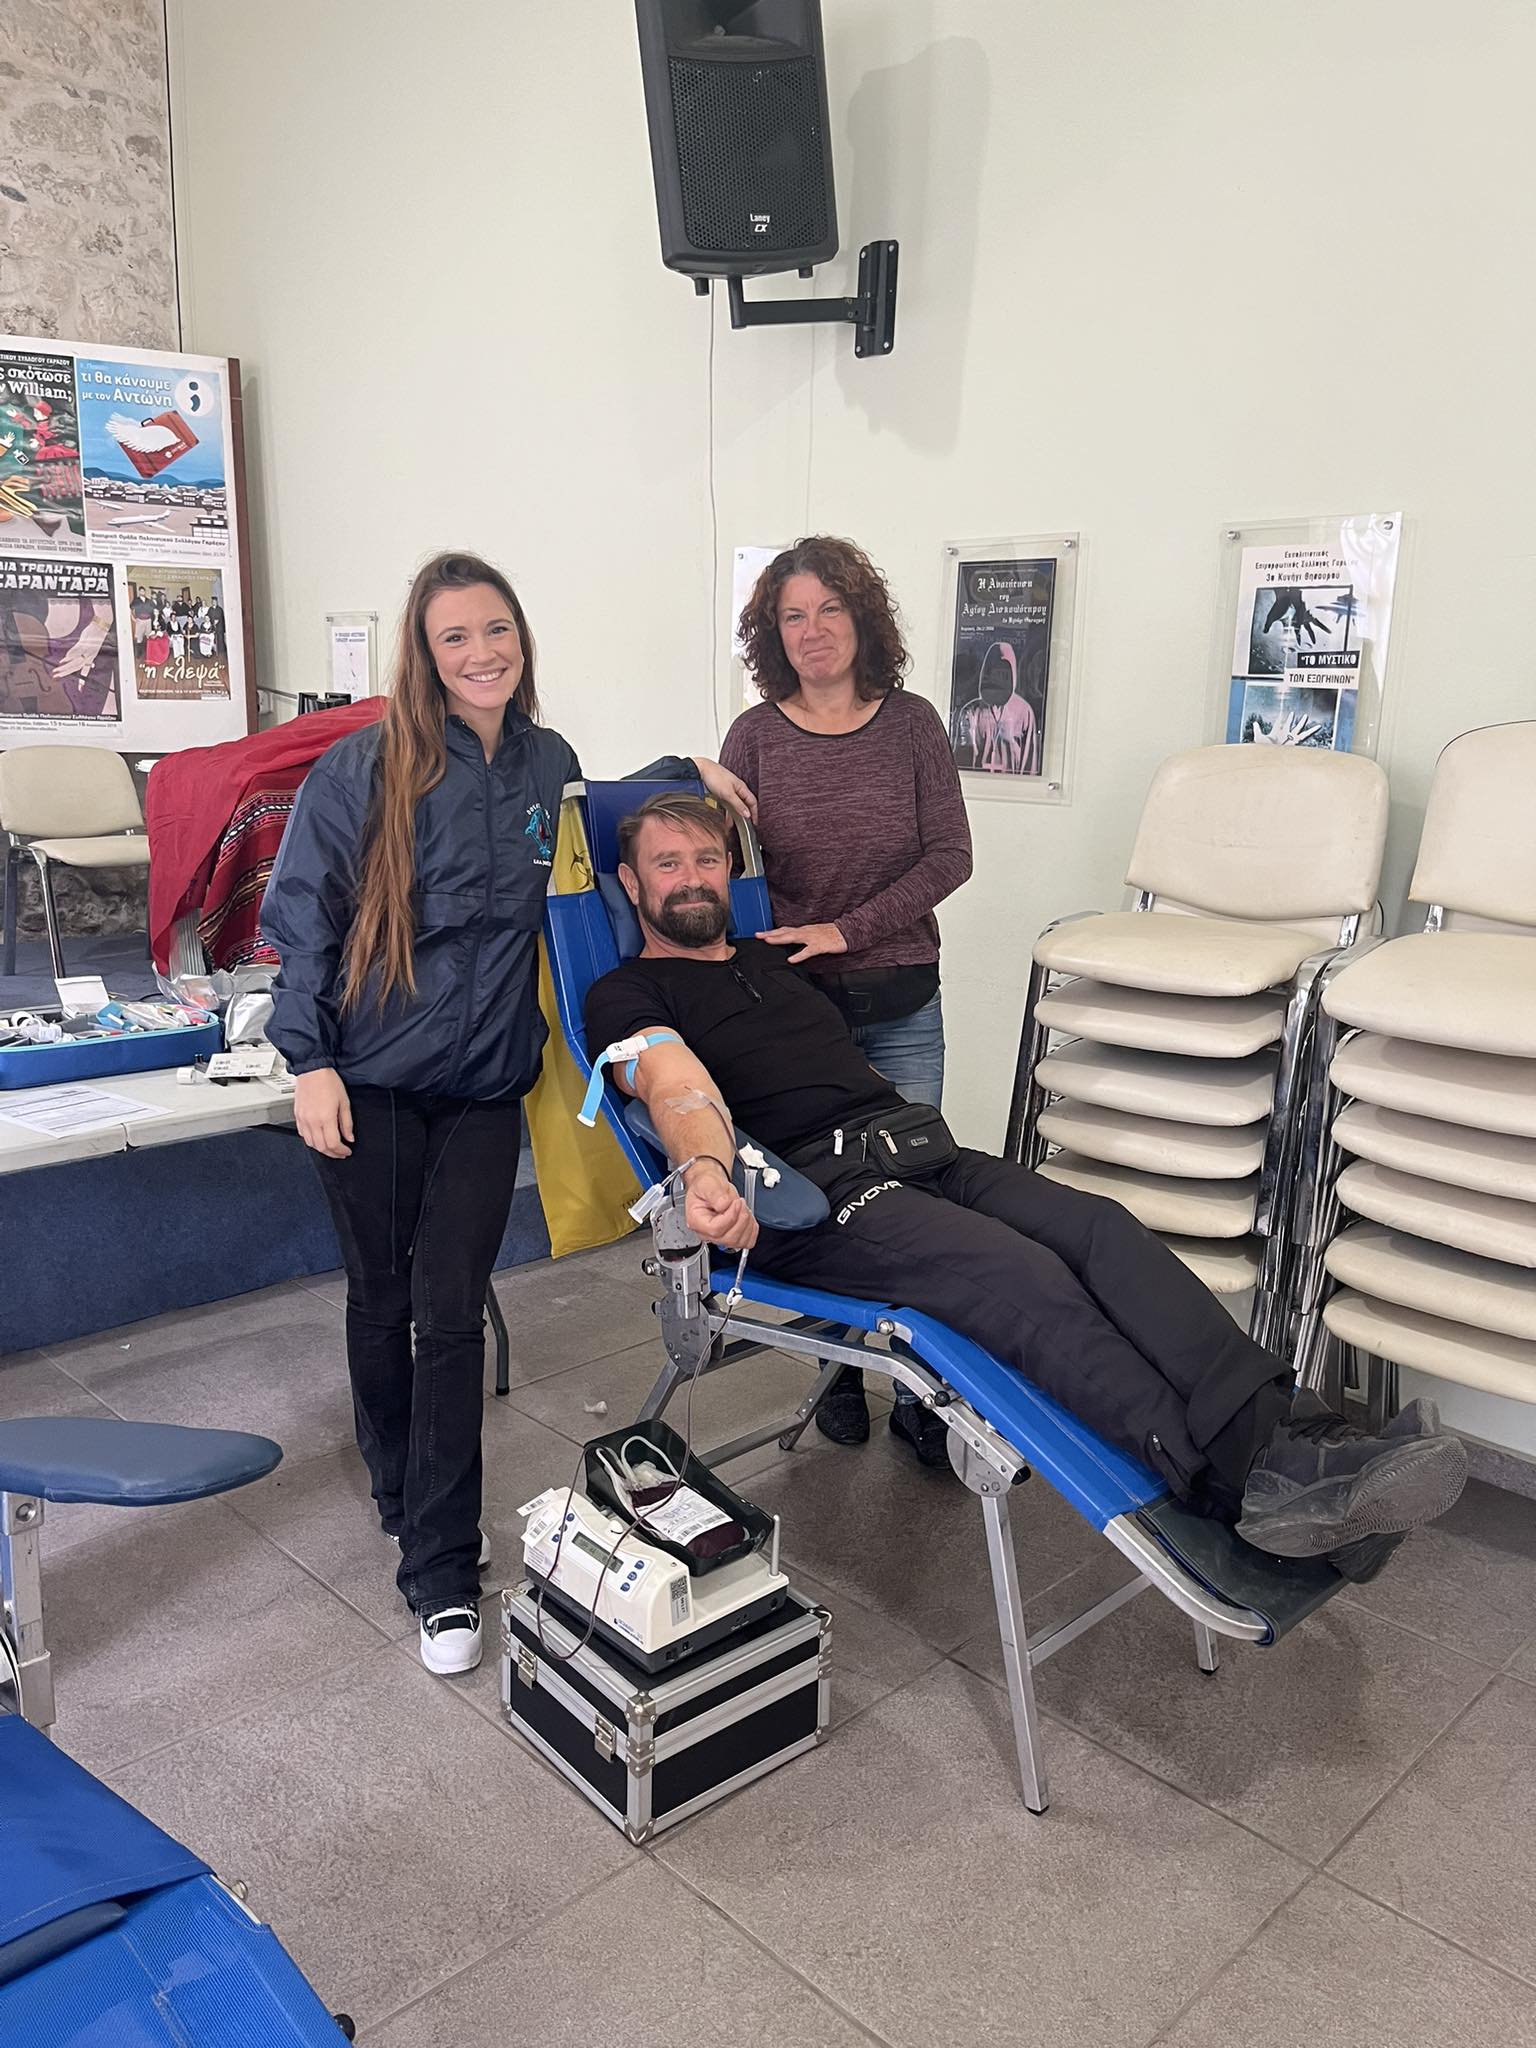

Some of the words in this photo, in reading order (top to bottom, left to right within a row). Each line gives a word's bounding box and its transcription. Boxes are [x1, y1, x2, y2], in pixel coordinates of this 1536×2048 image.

[750, 213, 770, 223] Laney
[754, 224, 768, 232] CX
[8, 365, 71, 384] σκότωσε
[81, 372, 92, 383] τι
[94, 371, 112, 385] θα
[115, 373, 171, 392] κάνουμε
[82, 391, 93, 401] με
[95, 392, 111, 401] τον
[113, 388, 172, 407] Αντώνη
[1318, 653, 1357, 666] ΜΥΣΤΙΚΟ
[1289, 673, 1304, 683] ΤΩΝ
[837, 1180, 903, 1225] GIVOVA
